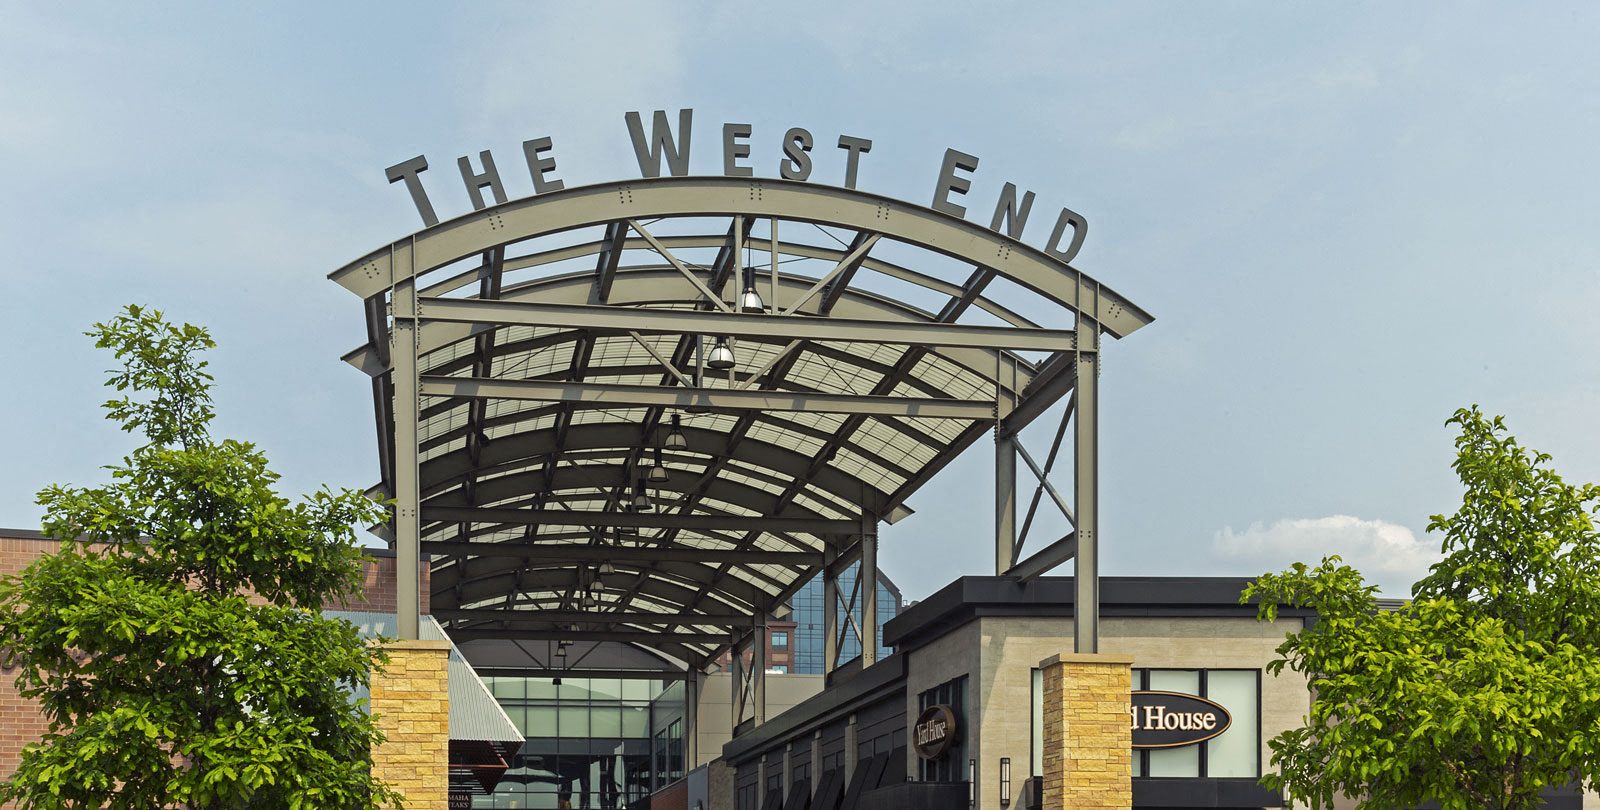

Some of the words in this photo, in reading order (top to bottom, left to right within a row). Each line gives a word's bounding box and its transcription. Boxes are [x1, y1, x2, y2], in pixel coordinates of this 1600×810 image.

[385, 136, 565, 228] THE
[625, 108, 873, 189] WEST
[931, 147, 1089, 264] END
[1143, 706, 1217, 730] House
